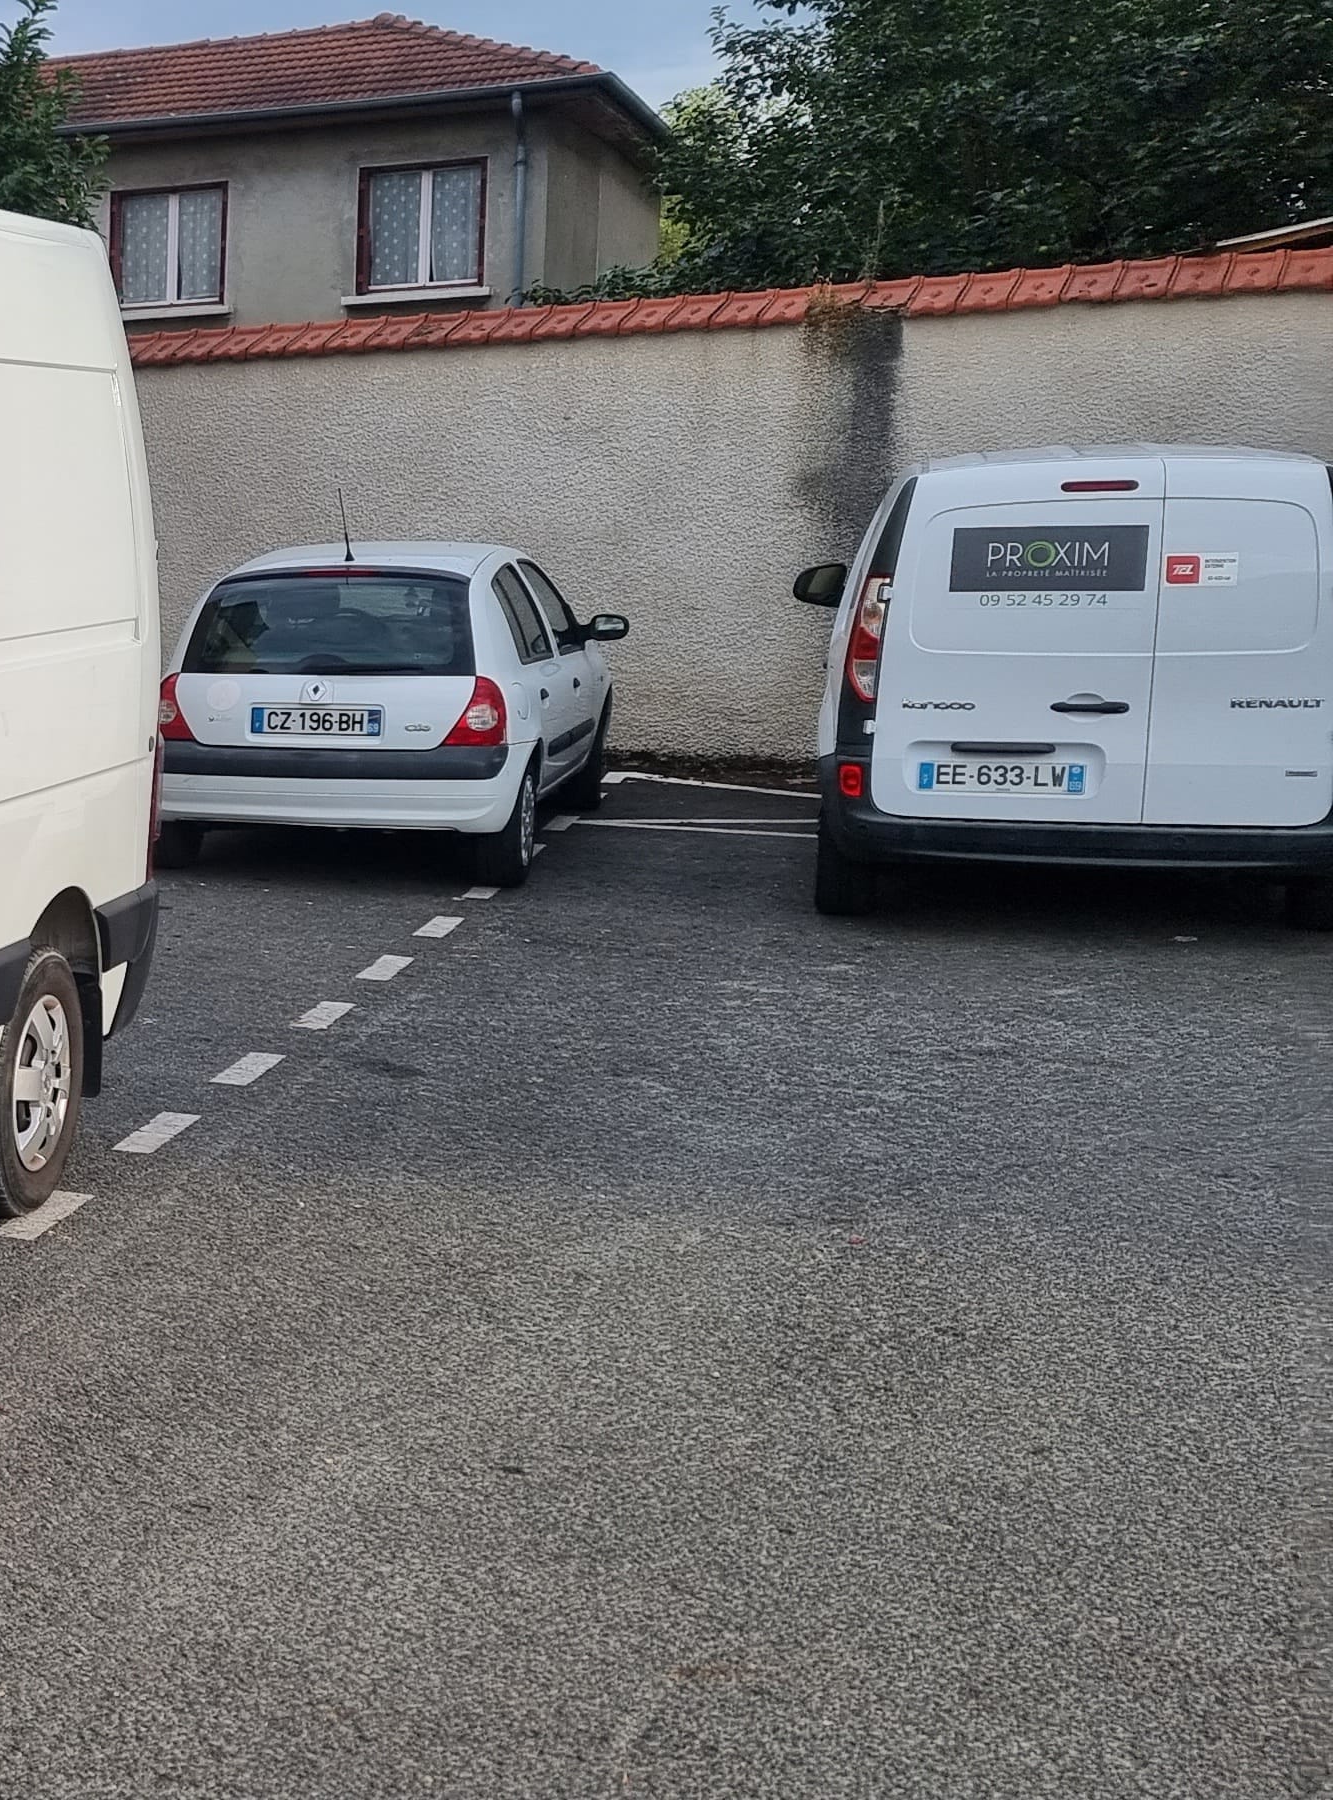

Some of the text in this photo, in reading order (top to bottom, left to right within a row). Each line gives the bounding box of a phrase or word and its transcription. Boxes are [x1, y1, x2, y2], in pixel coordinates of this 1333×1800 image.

[987, 540, 1110, 568] PROXIM
[979, 593, 1108, 607] 09 52 45 29 74
[1229, 697, 1325, 709] RENAULT
[267, 711, 365, 732] CZ-196-BH
[935, 764, 1066, 788] EE-633-LW
